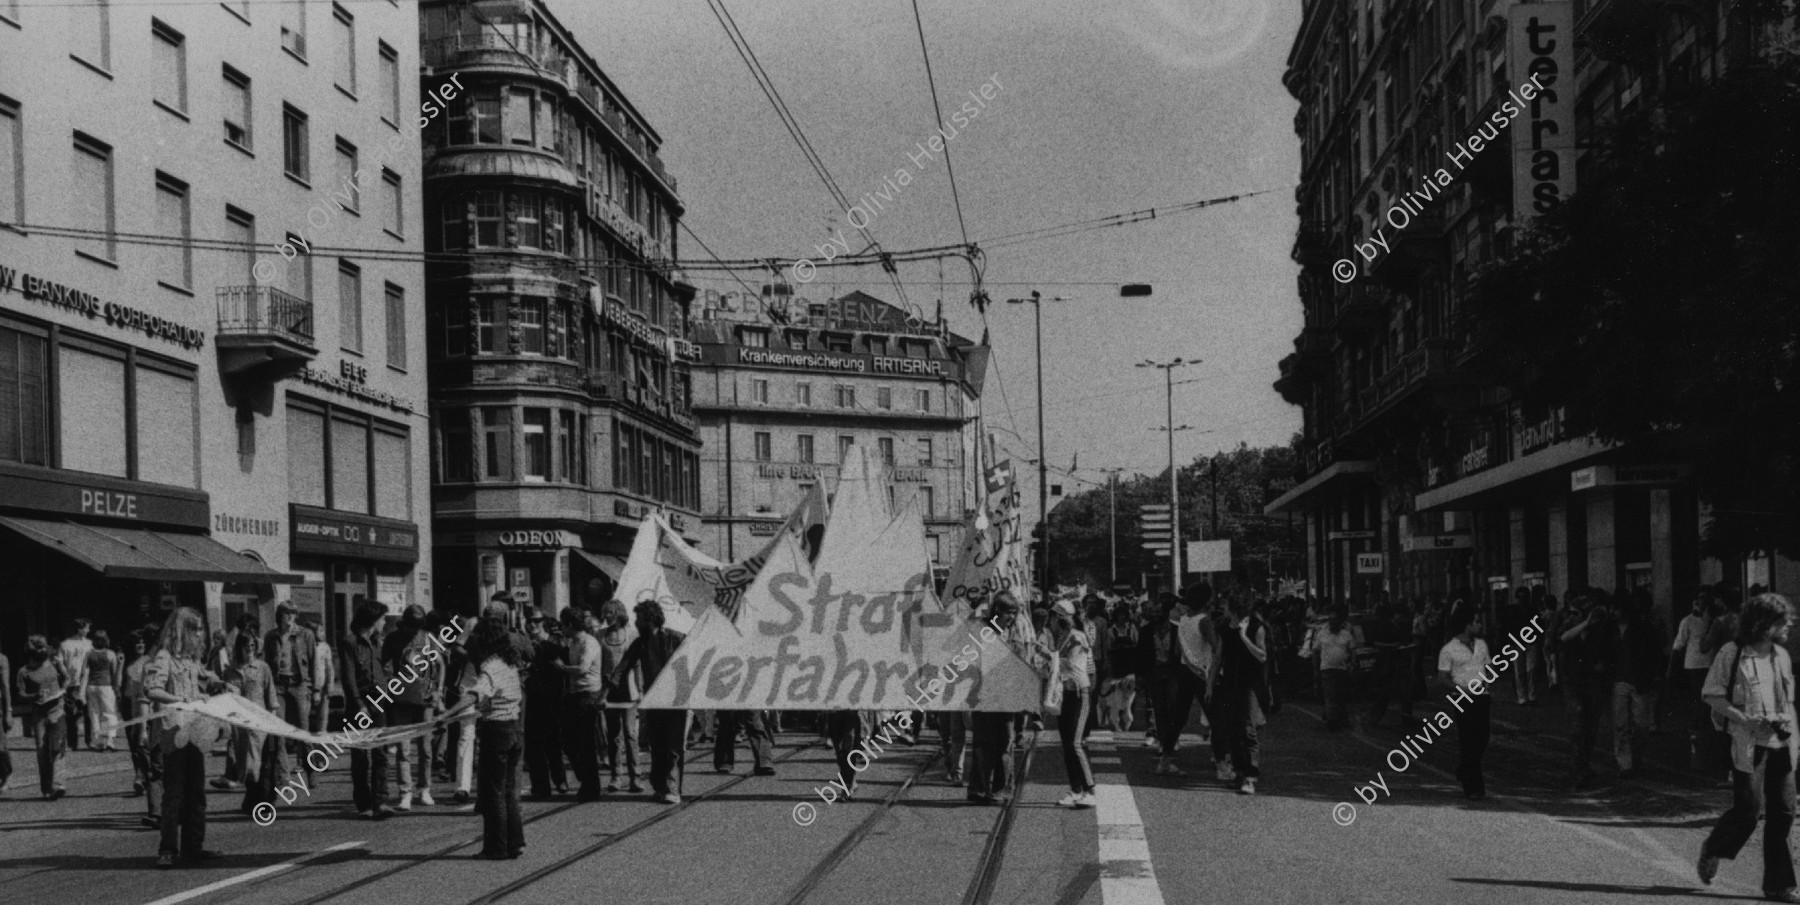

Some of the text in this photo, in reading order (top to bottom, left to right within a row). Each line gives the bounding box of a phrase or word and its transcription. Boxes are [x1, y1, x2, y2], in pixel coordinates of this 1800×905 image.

[26, 275, 100, 314] BANKING
[107, 302, 204, 346] CORPORATION
[739, 348, 942, 374] Krankenversicherung ARTISANA
[81, 489, 137, 518] PELZE
[215, 513, 280, 537] ZÜRCHERHOF
[500, 530, 564, 547] ODEON
[1434, 535, 1456, 549] bar
[1359, 557, 1381, 569] TAXI
